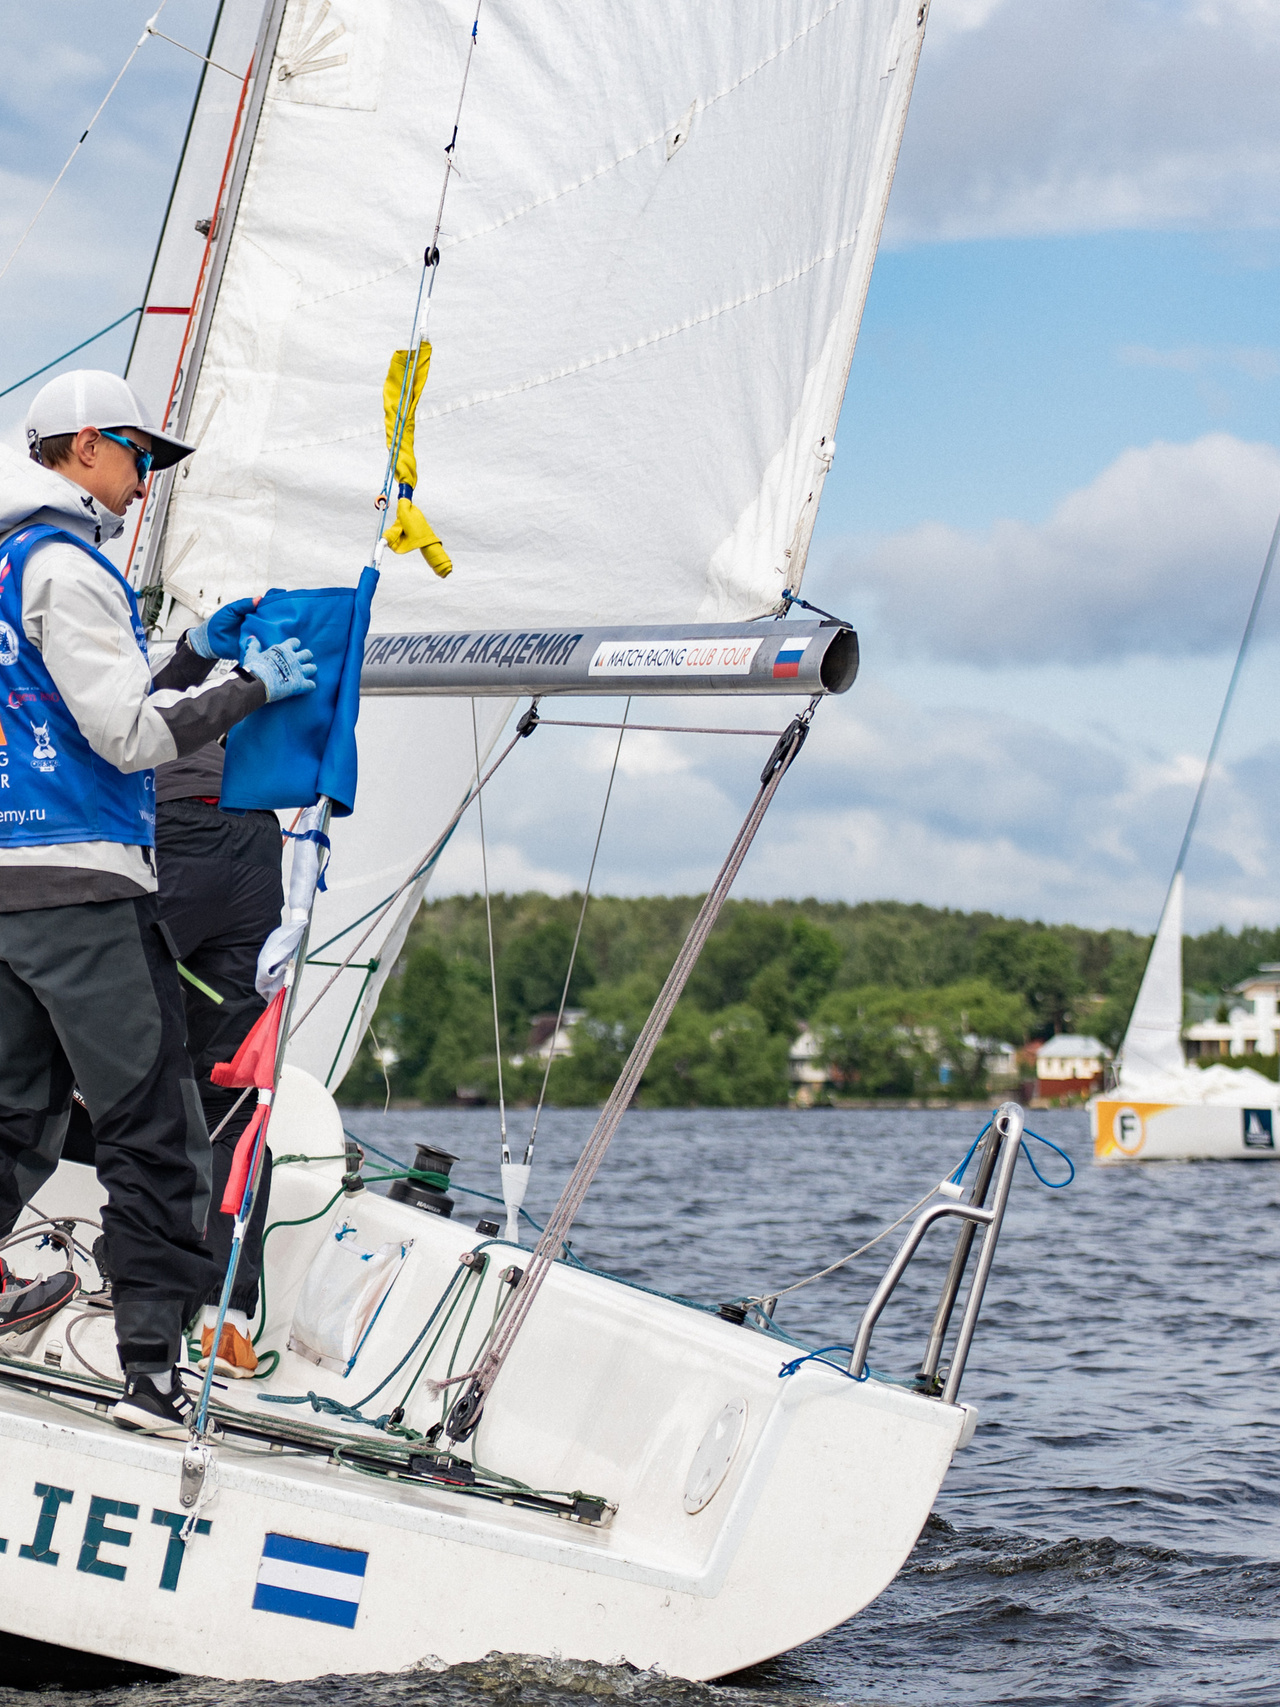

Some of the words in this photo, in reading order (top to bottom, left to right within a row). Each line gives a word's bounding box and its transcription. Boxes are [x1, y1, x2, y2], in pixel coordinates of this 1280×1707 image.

[365, 634, 470, 665] ПАРУСНАЯ
[461, 634, 584, 668] АКАДЕМИЯ
[607, 649, 647, 667] MATCH
[643, 648, 687, 667] RACING
[686, 648, 718, 666] CLUB
[718, 647, 751, 666] TOUR
[1120, 1115, 1135, 1141] F
